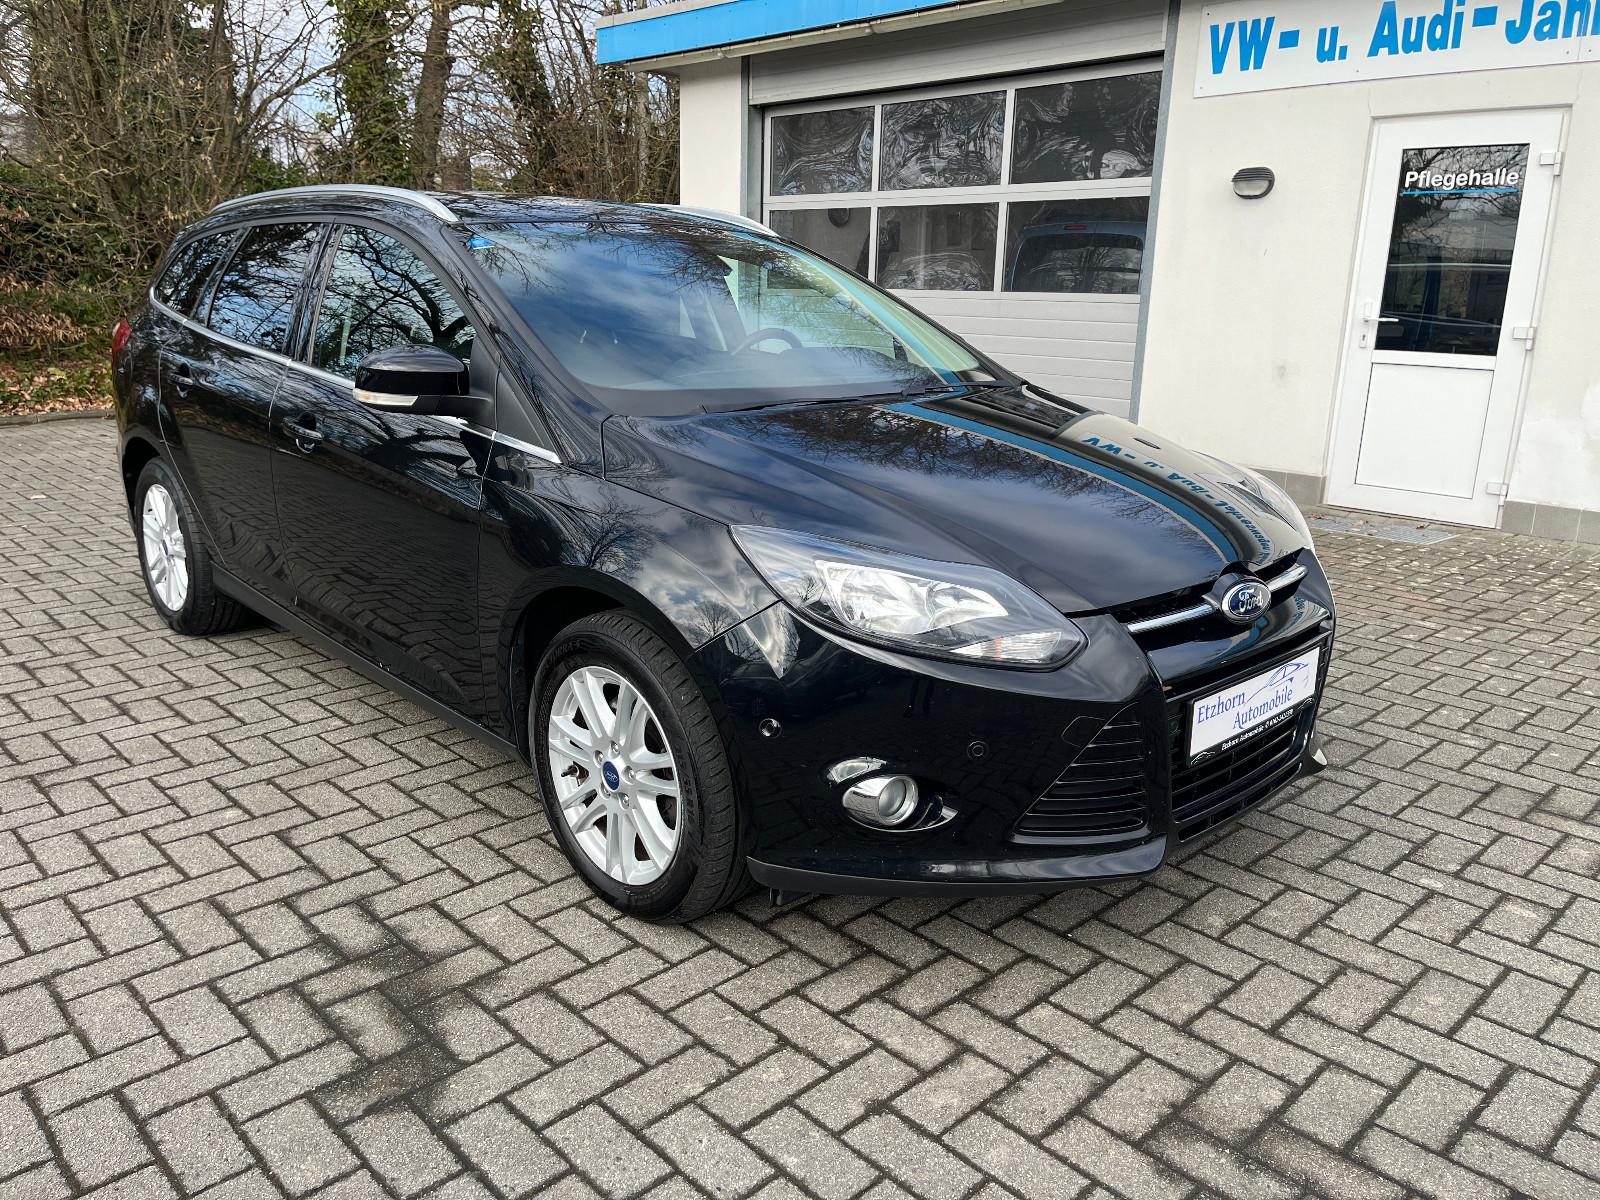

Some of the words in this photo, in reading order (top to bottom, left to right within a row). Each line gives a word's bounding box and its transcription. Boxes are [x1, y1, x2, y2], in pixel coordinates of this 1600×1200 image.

[1209, 15, 1300, 75] VW-
[1316, 26, 1348, 63] u.
[1404, 167, 1519, 191] Pflegehalle
[1237, 588, 1264, 613] Ford
[1197, 691, 1246, 724] Etzhorn
[1233, 685, 1293, 730] Automobile
